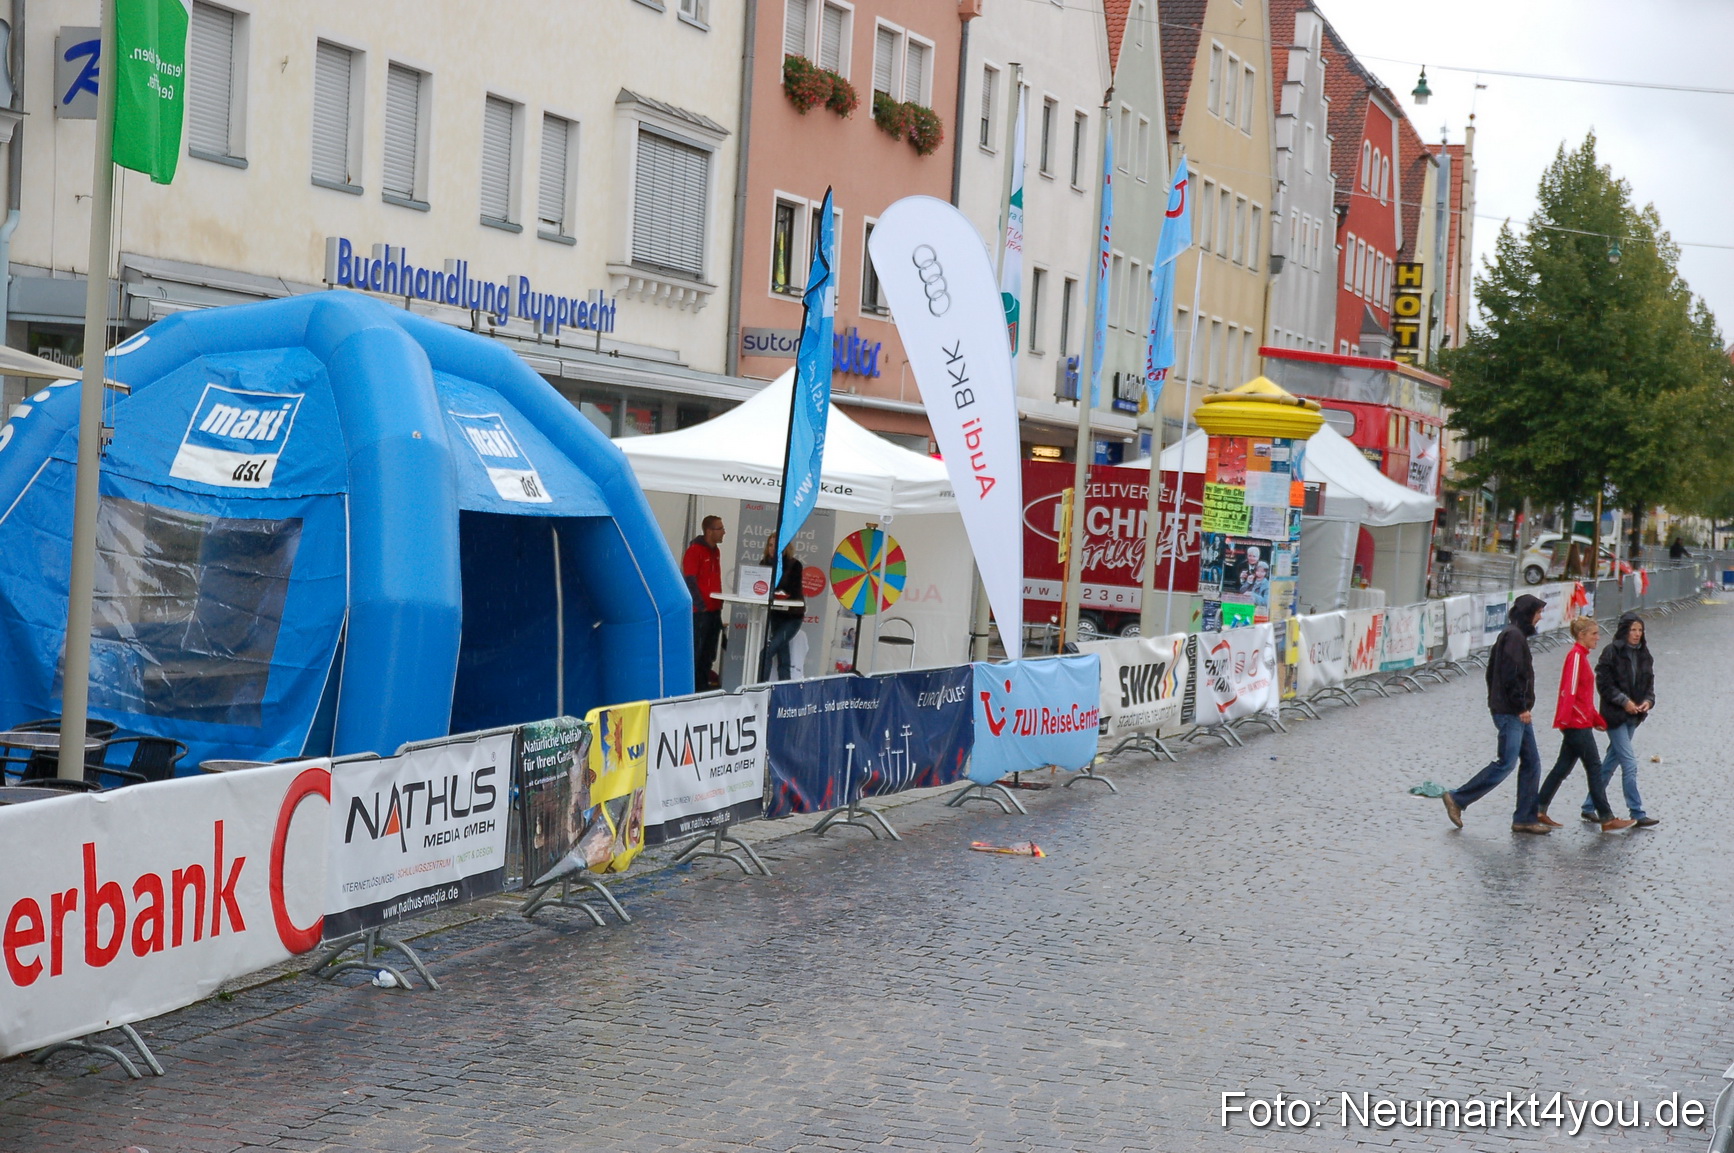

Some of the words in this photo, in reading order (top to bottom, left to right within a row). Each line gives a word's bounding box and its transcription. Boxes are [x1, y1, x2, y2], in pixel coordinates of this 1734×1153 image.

[333, 237, 510, 327] Buchhandlung
[514, 275, 616, 335] Rupprecht
[199, 402, 292, 441] maxi
[465, 424, 519, 458] maxi
[231, 459, 261, 483] dsl
[520, 475, 544, 499] dsl
[1012, 708, 1038, 736] TUI
[523, 758, 535, 773] für
[536, 754, 556, 770] Ihren
[656, 715, 757, 782] NATHUS
[345, 766, 496, 853] NATHUS
[423, 828, 461, 848] MEDIA
[464, 819, 496, 839] GMBH
[383, 886, 459, 919] www.nathus-media.de
